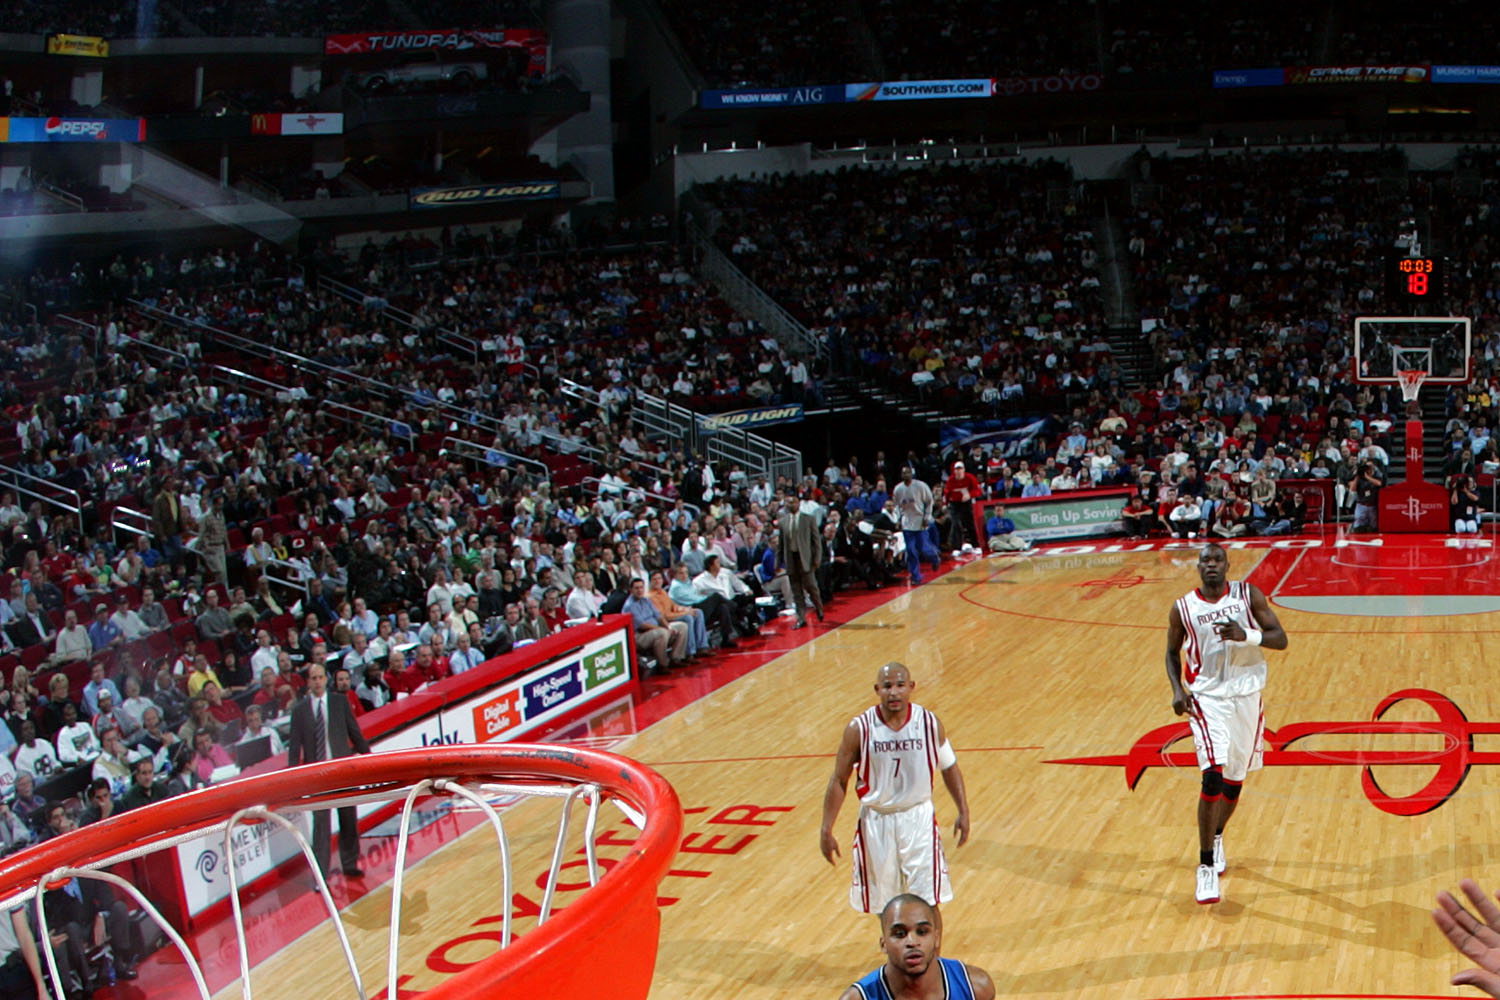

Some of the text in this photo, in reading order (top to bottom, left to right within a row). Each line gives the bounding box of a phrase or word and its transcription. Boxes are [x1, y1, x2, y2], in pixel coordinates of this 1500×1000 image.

[366, 33, 458, 51] TUNDRA
[721, 92, 788, 104] WE KNOW MONEY
[790, 87, 824, 104] AIG
[882, 83, 984, 96] SOUTHWEST.COM
[60, 121, 105, 136] PEPSI
[428, 183, 557, 201] BUD LIGHT
[1399, 259, 1433, 273] 10:03
[1408, 272, 1428, 296] 18
[750, 407, 801, 423] LIGHT
[1030, 506, 1121, 525] Ring Up Savin
[1196, 603, 1242, 626] ROCKETS
[594, 649, 617, 668] Digital
[596, 664, 617, 681] Phone
[532, 669, 573, 698] High-Speed
[542, 690, 566, 708] Online
[483, 698, 510, 721] Digital
[486, 714, 511, 735] Cable
[873, 738, 923, 753] ROCKETS
[892, 758, 901, 778] 7
[218, 829, 250, 858] TME
